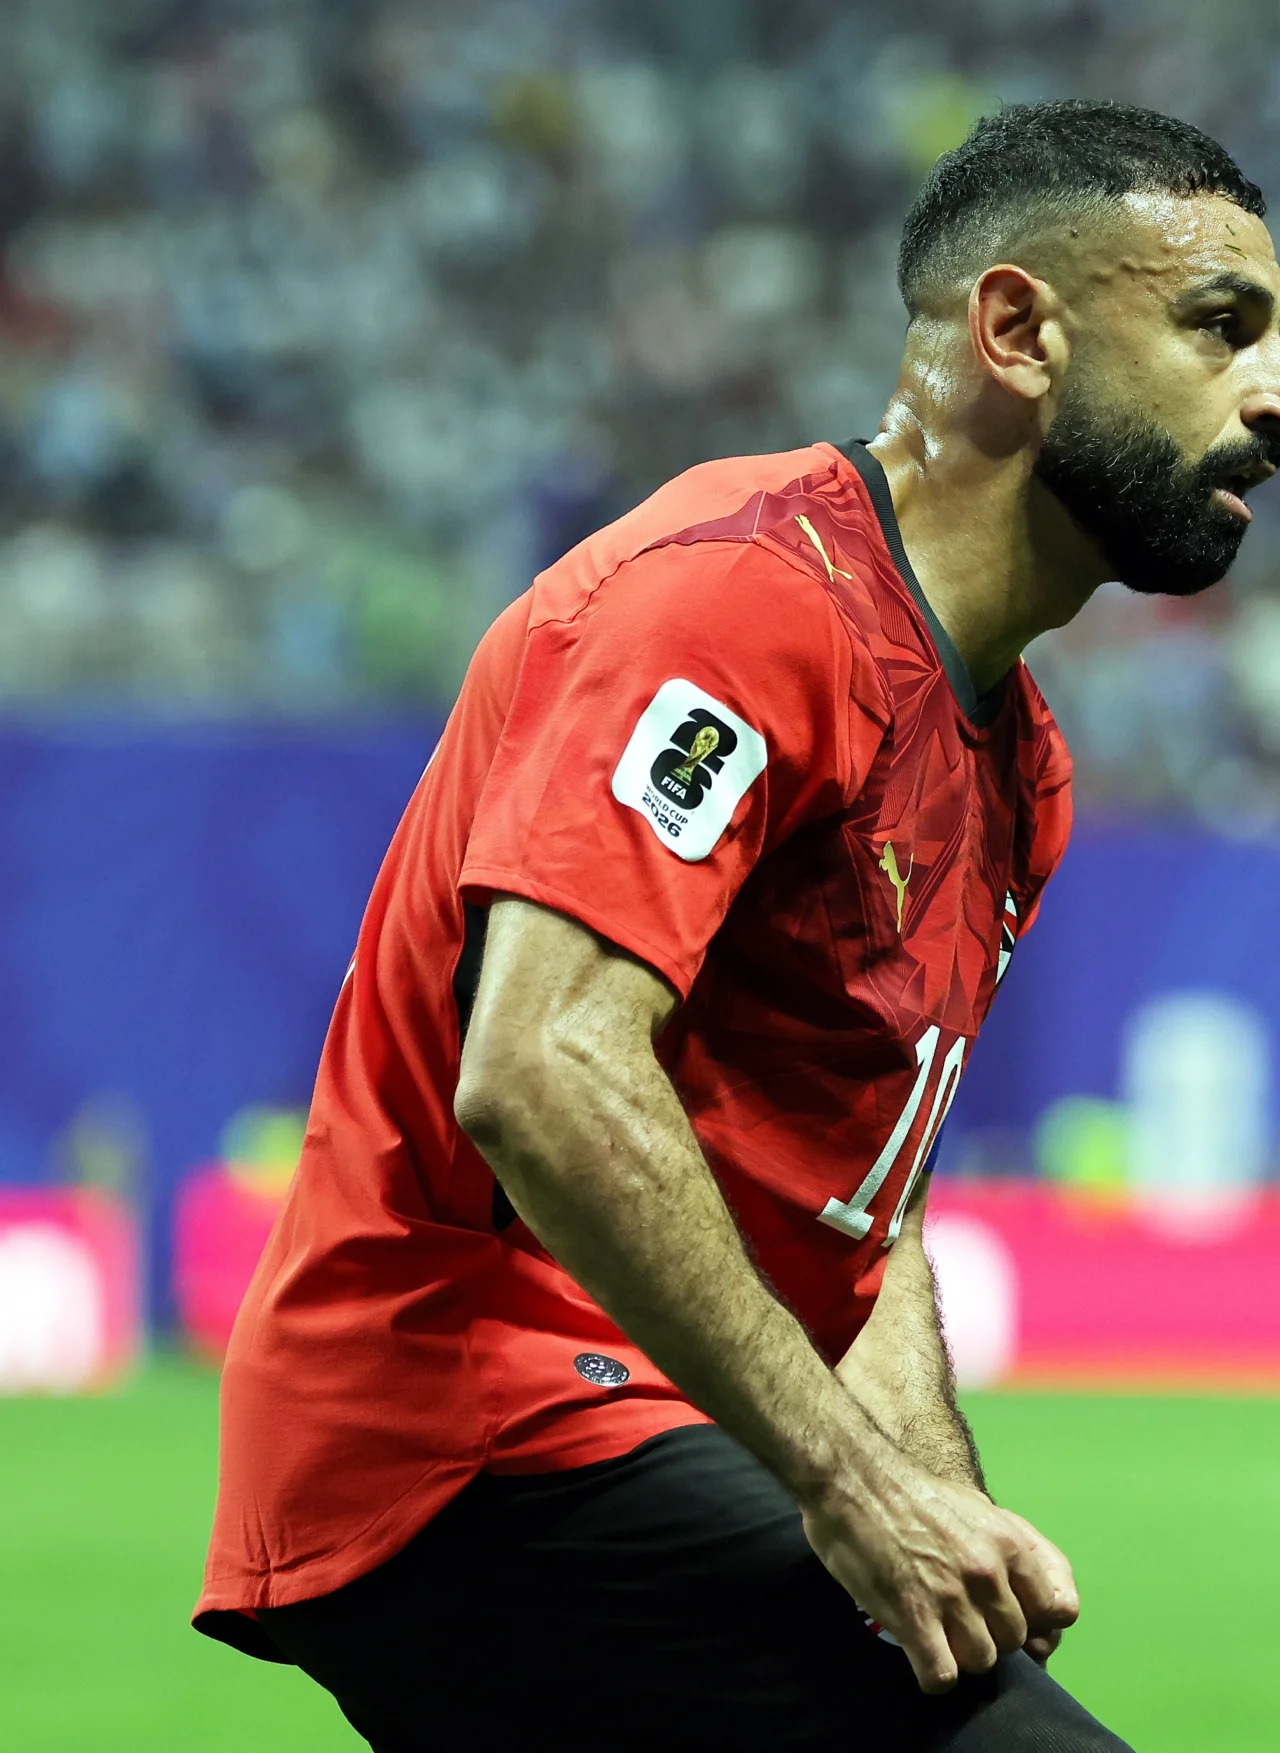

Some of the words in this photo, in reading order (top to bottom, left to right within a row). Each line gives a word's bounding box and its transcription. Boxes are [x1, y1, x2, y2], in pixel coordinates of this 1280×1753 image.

[645, 784, 669, 812] WORLD
[669, 809, 688, 824] CUP
[661, 776, 687, 800] FIFA
[642, 792, 682, 837] 2026
[816, 1024, 966, 1247] 10
